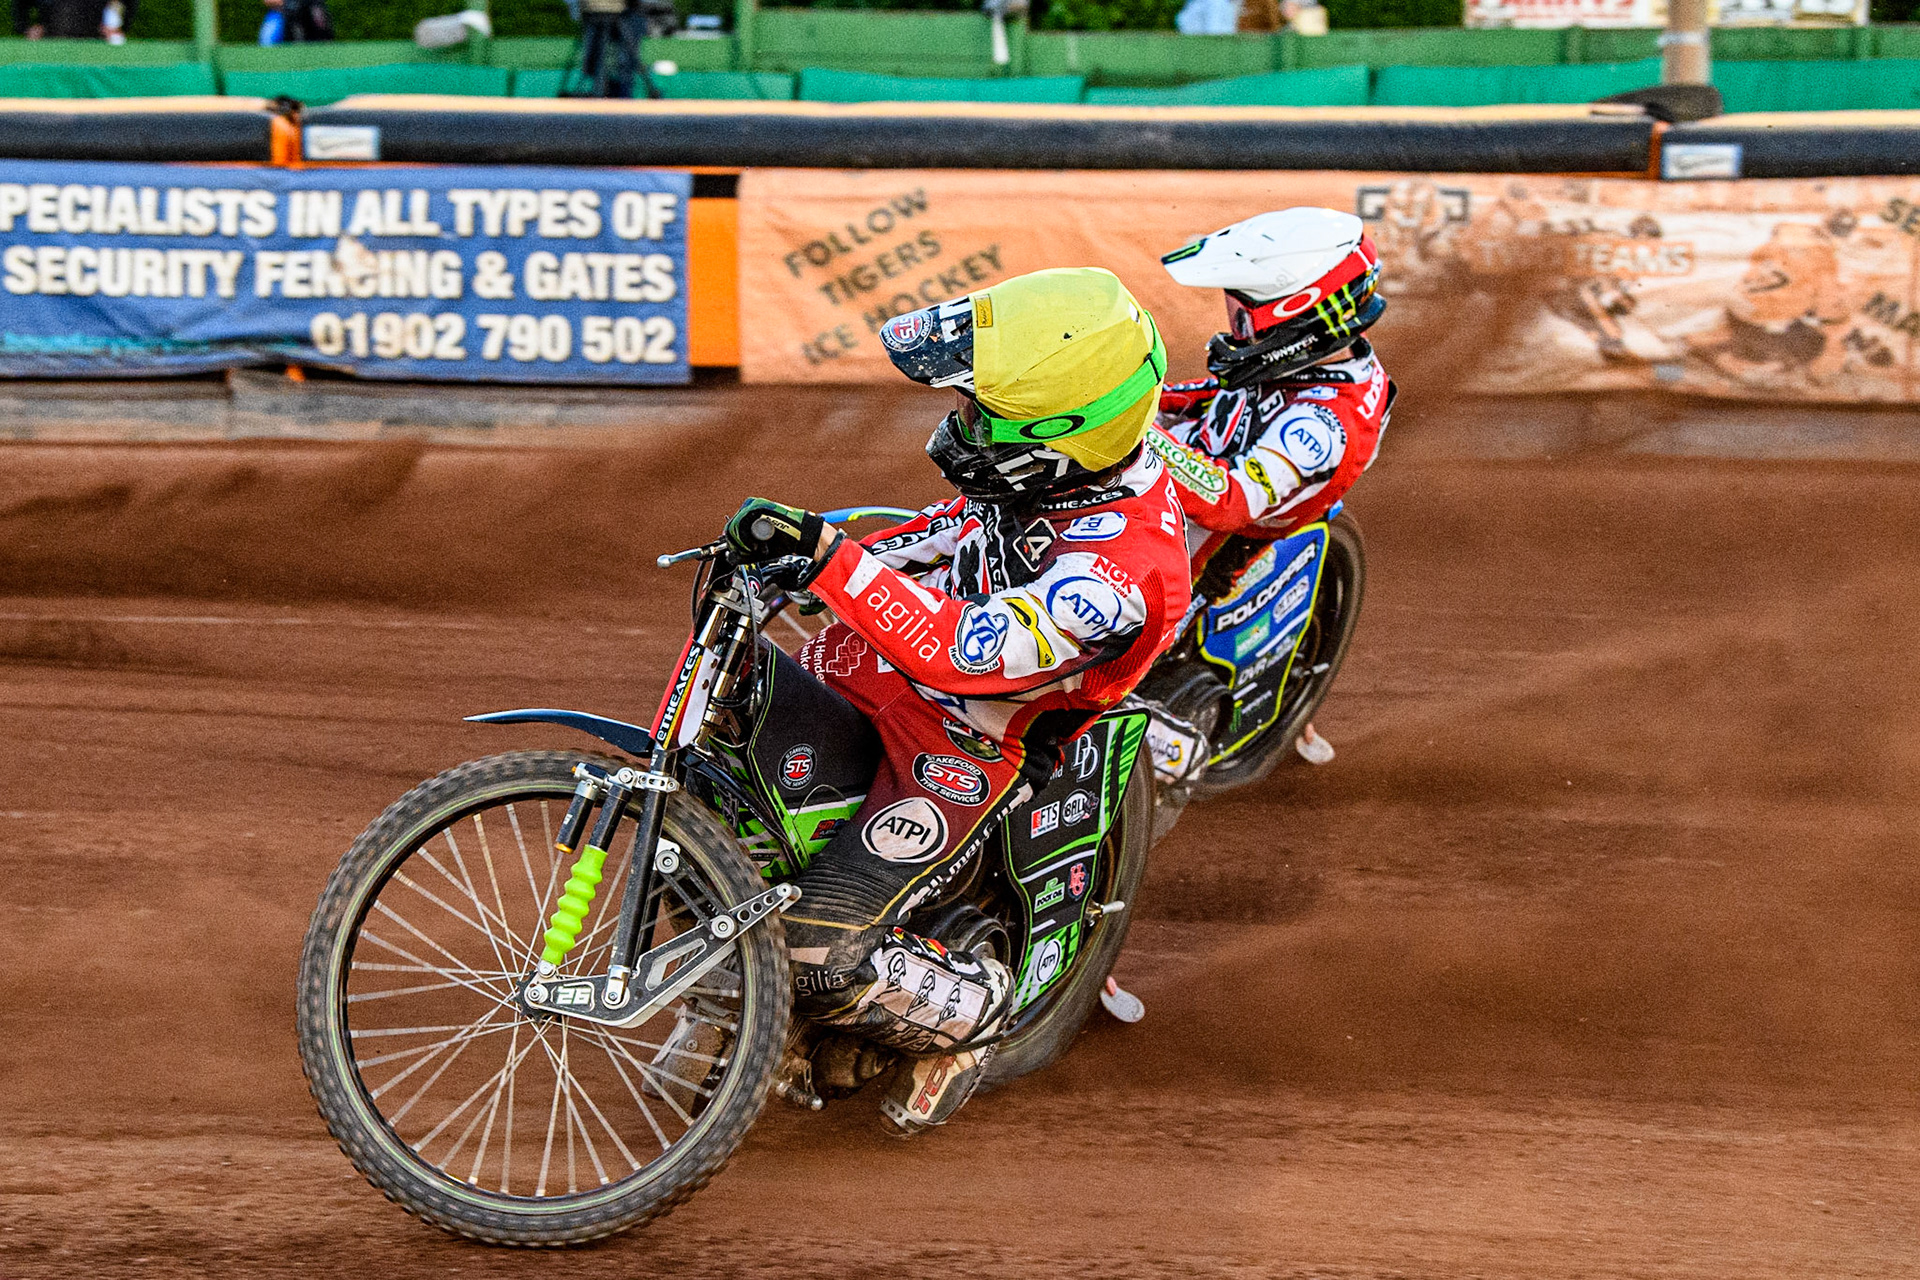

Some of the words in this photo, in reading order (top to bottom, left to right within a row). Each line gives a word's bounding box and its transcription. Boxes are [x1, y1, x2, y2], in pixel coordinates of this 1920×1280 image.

[288, 188, 343, 238] IN
[351, 189, 442, 238] ALL
[448, 189, 602, 238] TYPES
[610, 191, 677, 239] OF
[783, 187, 929, 279] FOLLOW
[2, 244, 244, 298] SECURITY
[472, 251, 514, 299] &
[523, 252, 676, 302] GATES
[818, 229, 942, 306] TIGERS
[801, 323, 858, 366] ICE
[862, 243, 1004, 335] HOCKEY
[310, 311, 467, 360] 01902
[476, 313, 572, 362] 790
[581, 315, 677, 364] 502
[1146, 431, 1218, 488] GROMIX
[1289, 427, 1324, 461] ATPI
[1092, 555, 1134, 594] NGK
[867, 584, 943, 663] agilia
[1060, 592, 1109, 631] ATPI
[785, 758, 811, 774] STS
[925, 763, 979, 790] STS
[920, 777, 940, 791] TYRE
[939, 788, 980, 803] SERVICES
[876, 815, 932, 846] ATPI
[1040, 803, 1058, 827] FTS
[1040, 954, 1056, 971] ATPI
[556, 985, 592, 1006] 26
[796, 970, 844, 997] gilia
